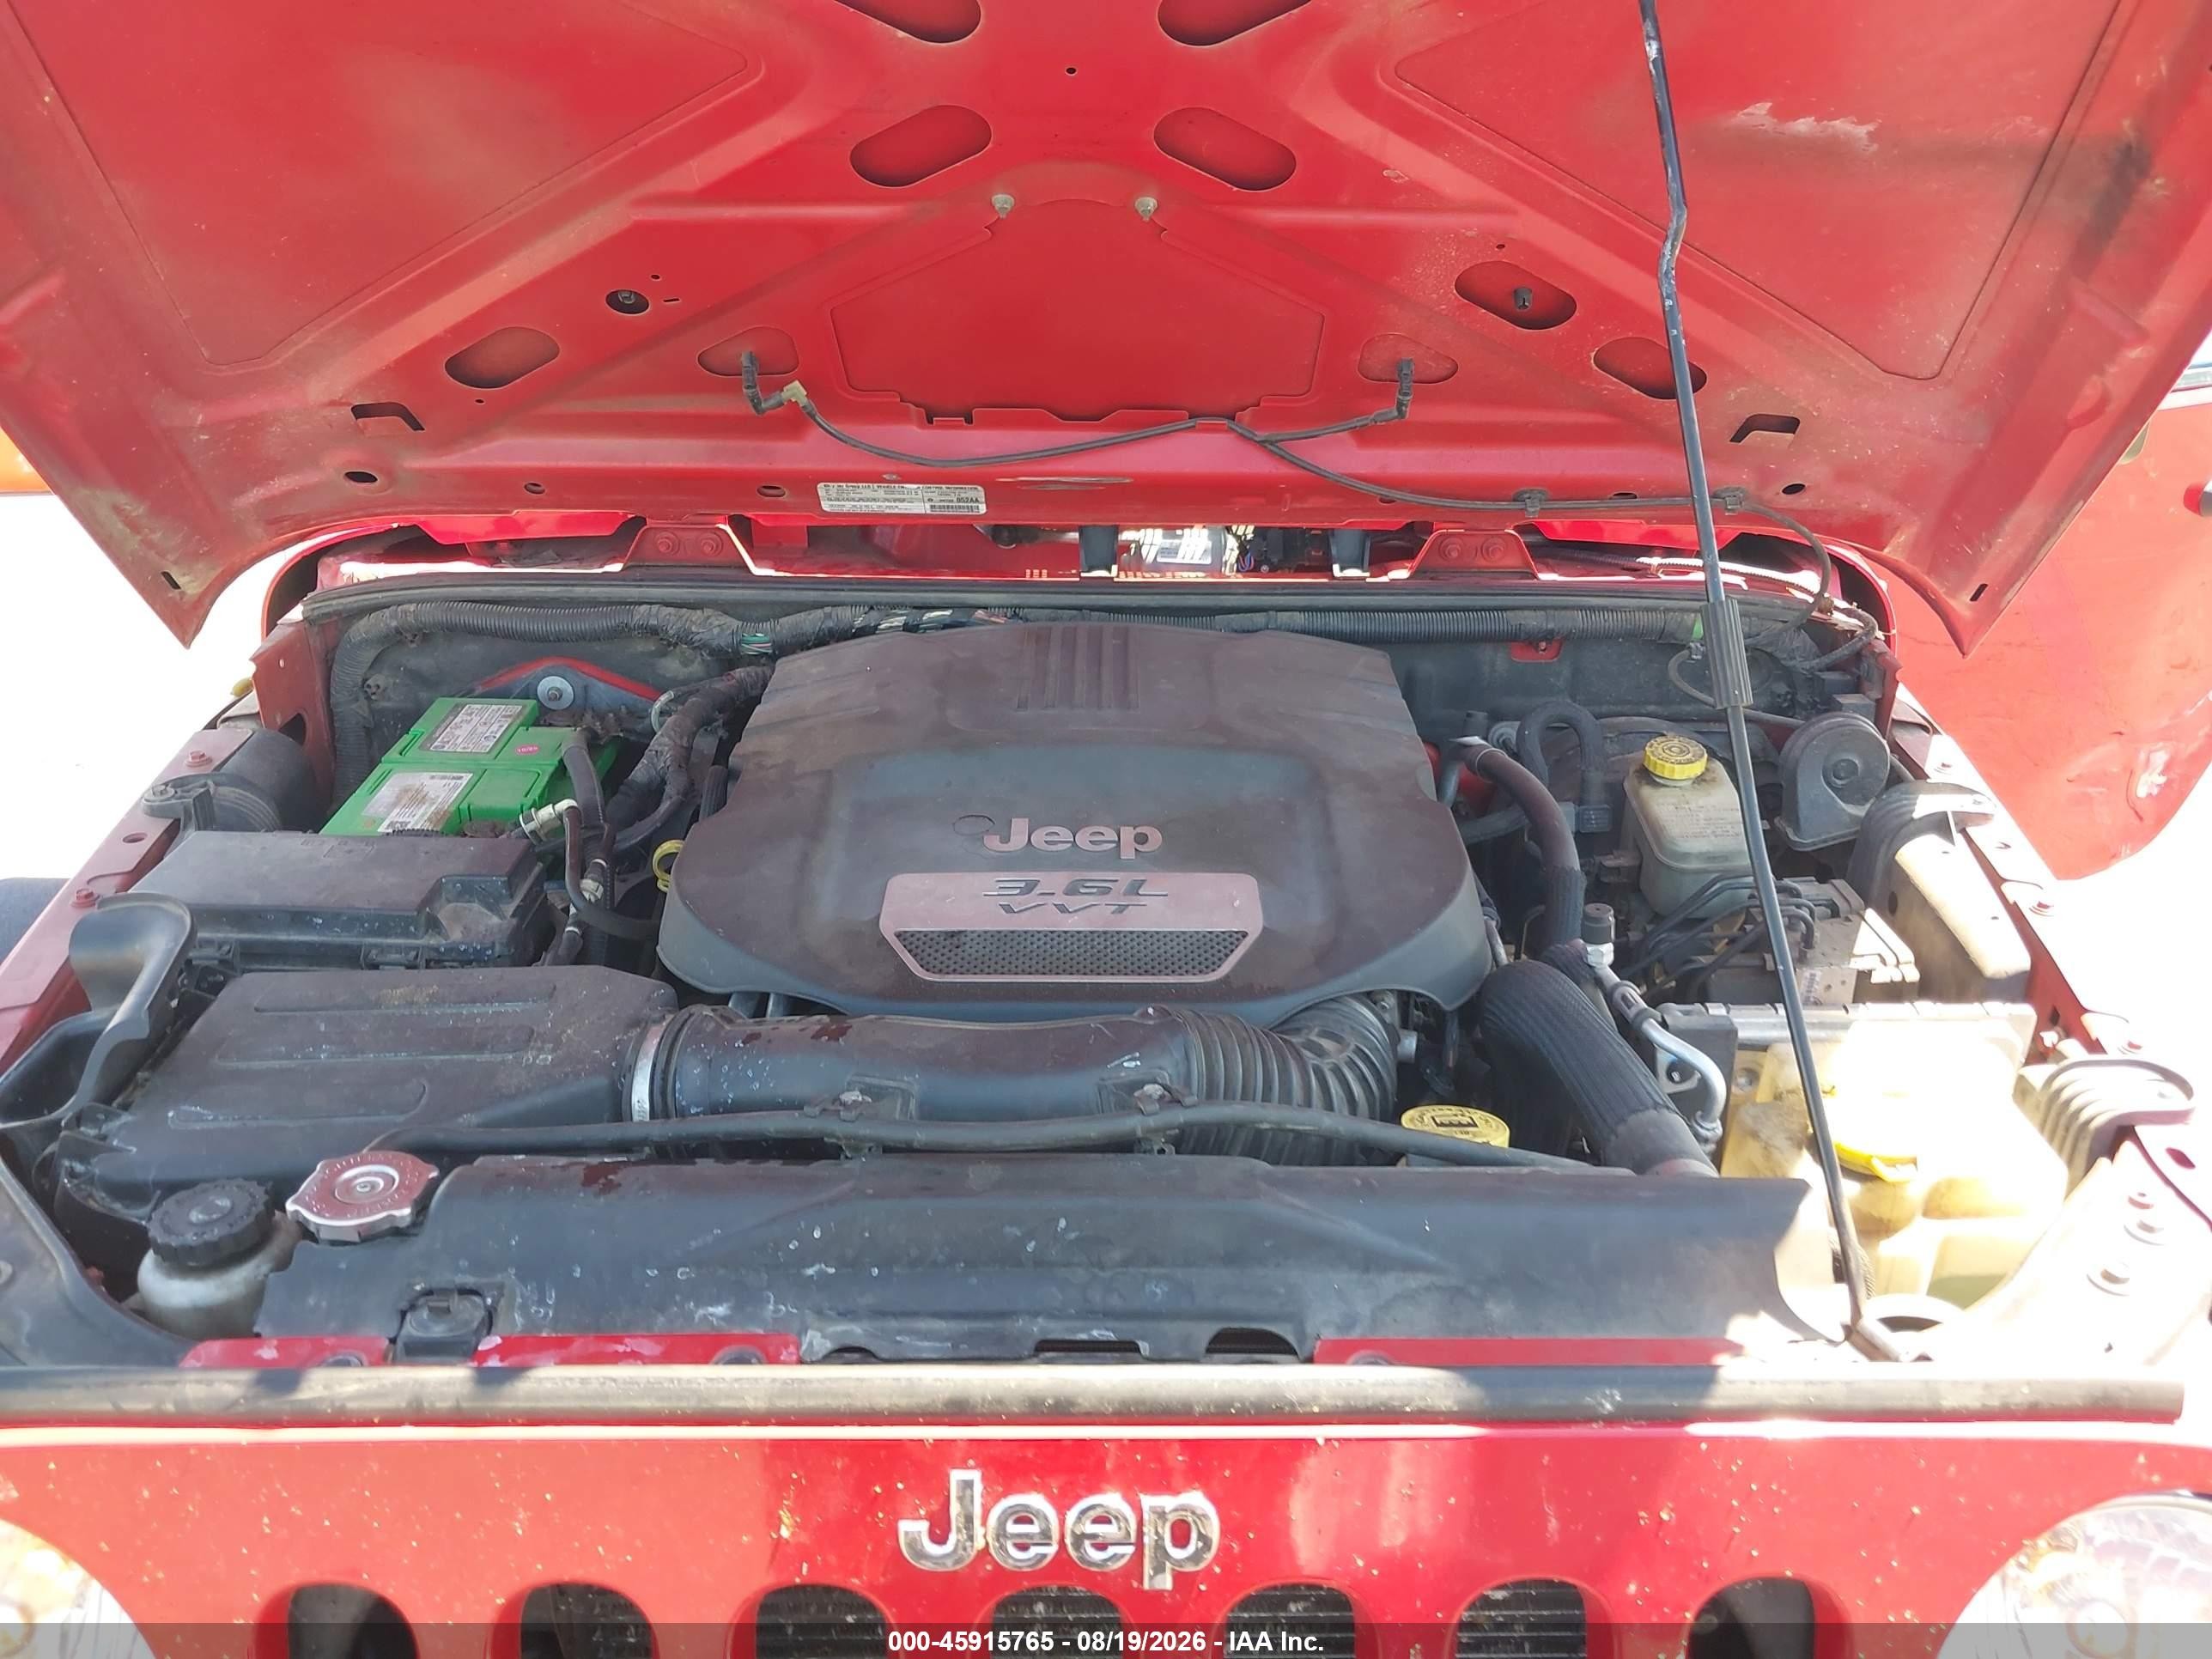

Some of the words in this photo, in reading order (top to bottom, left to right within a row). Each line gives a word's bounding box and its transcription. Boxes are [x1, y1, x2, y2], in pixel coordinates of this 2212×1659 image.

[982, 817, 1163, 860] Jeep
[982, 877, 1169, 896] 3.6L
[999, 902, 1148, 915] VVT
[897, 1468, 1220, 1590] Jeep
